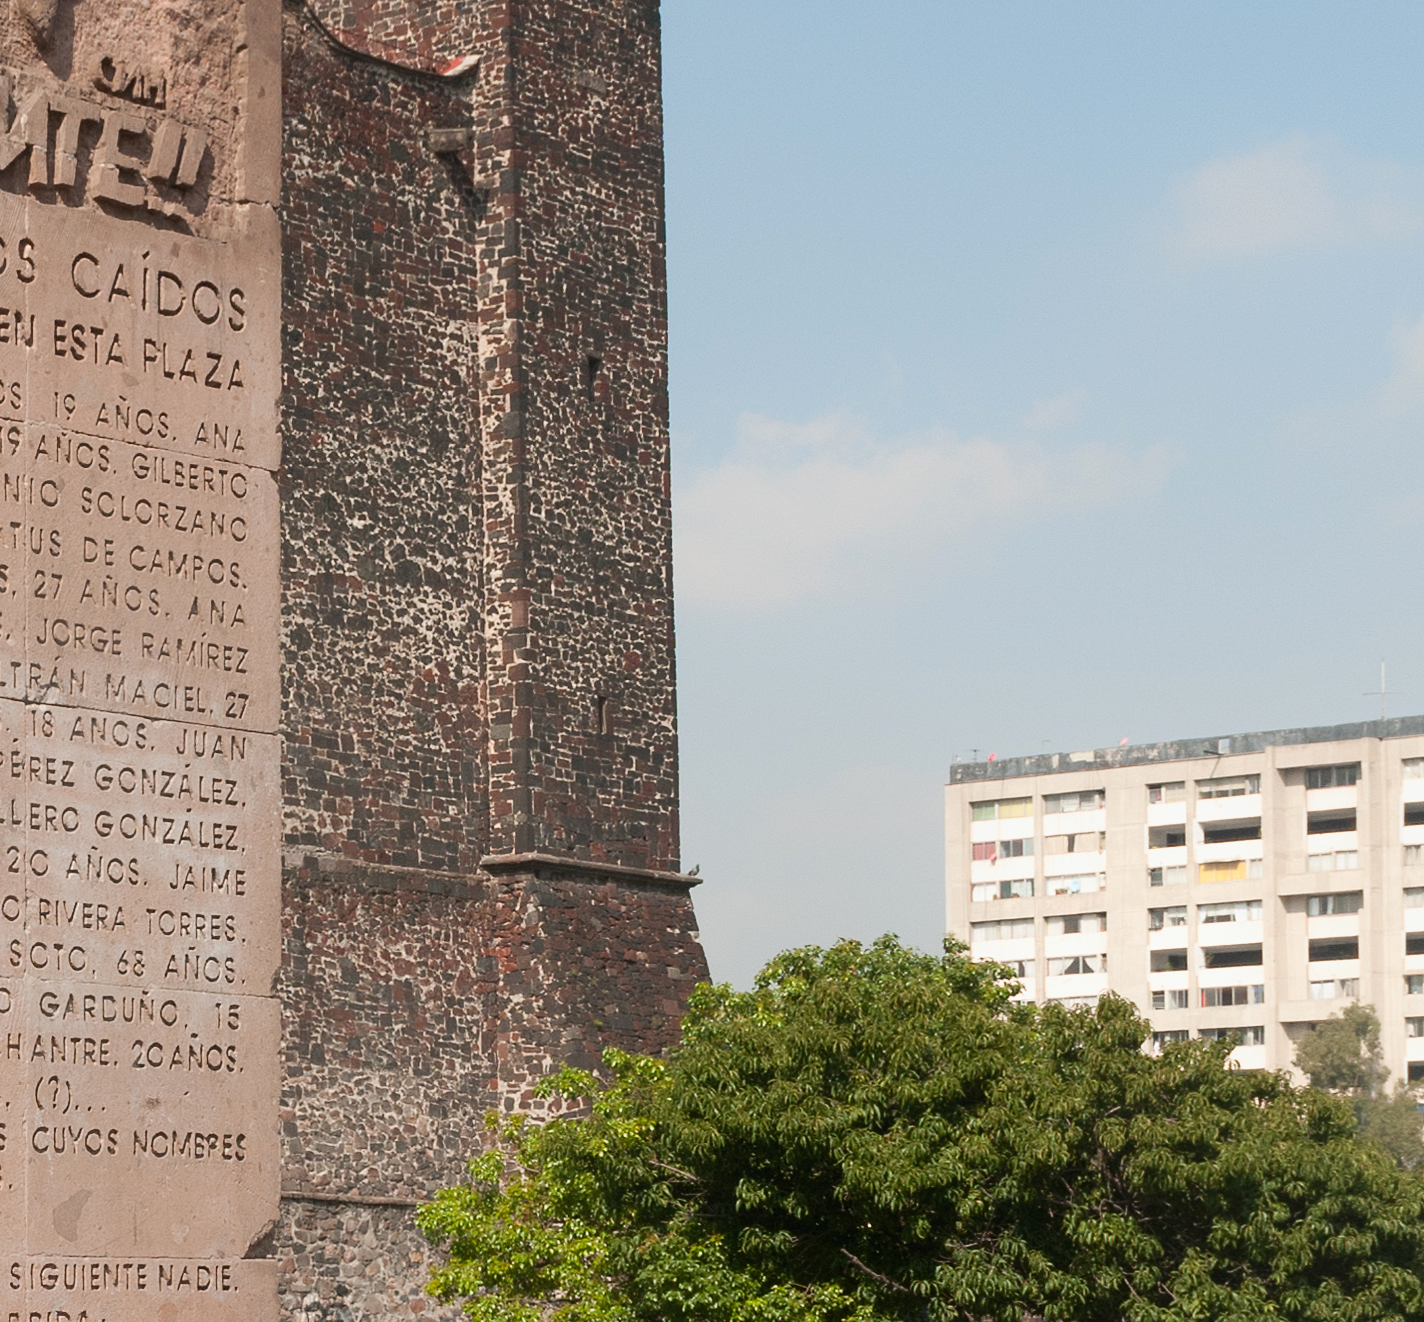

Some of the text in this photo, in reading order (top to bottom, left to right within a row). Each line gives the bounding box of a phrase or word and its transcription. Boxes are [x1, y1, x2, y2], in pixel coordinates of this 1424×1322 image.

[70, 248, 248, 334] CAÍDOS
[53, 315, 125, 369] ESTA
[143, 335, 246, 395] PLAZA
[53, 388, 76, 421] 19
[193, 417, 246, 454] ANA
[131, 450, 247, 501] GILBERTO
[82, 533, 115, 568] DE
[33, 567, 63, 601] 27
[187, 593, 246, 630] ANA
[35, 614, 122, 656] JORGE
[140, 631, 249, 675] RAMÍREZ
[224, 689, 249, 721] 27
[30, 707, 55, 738] 18
[175, 727, 247, 763] JUAN
[169, 861, 247, 897] JAIME
[37, 896, 127, 933] RIVERA
[116, 946, 146, 977] 68
[214, 1001, 240, 1031] 15
[30, 1124, 119, 1157] CUYOS
[8, 1260, 147, 1291] SIGUIENTE
